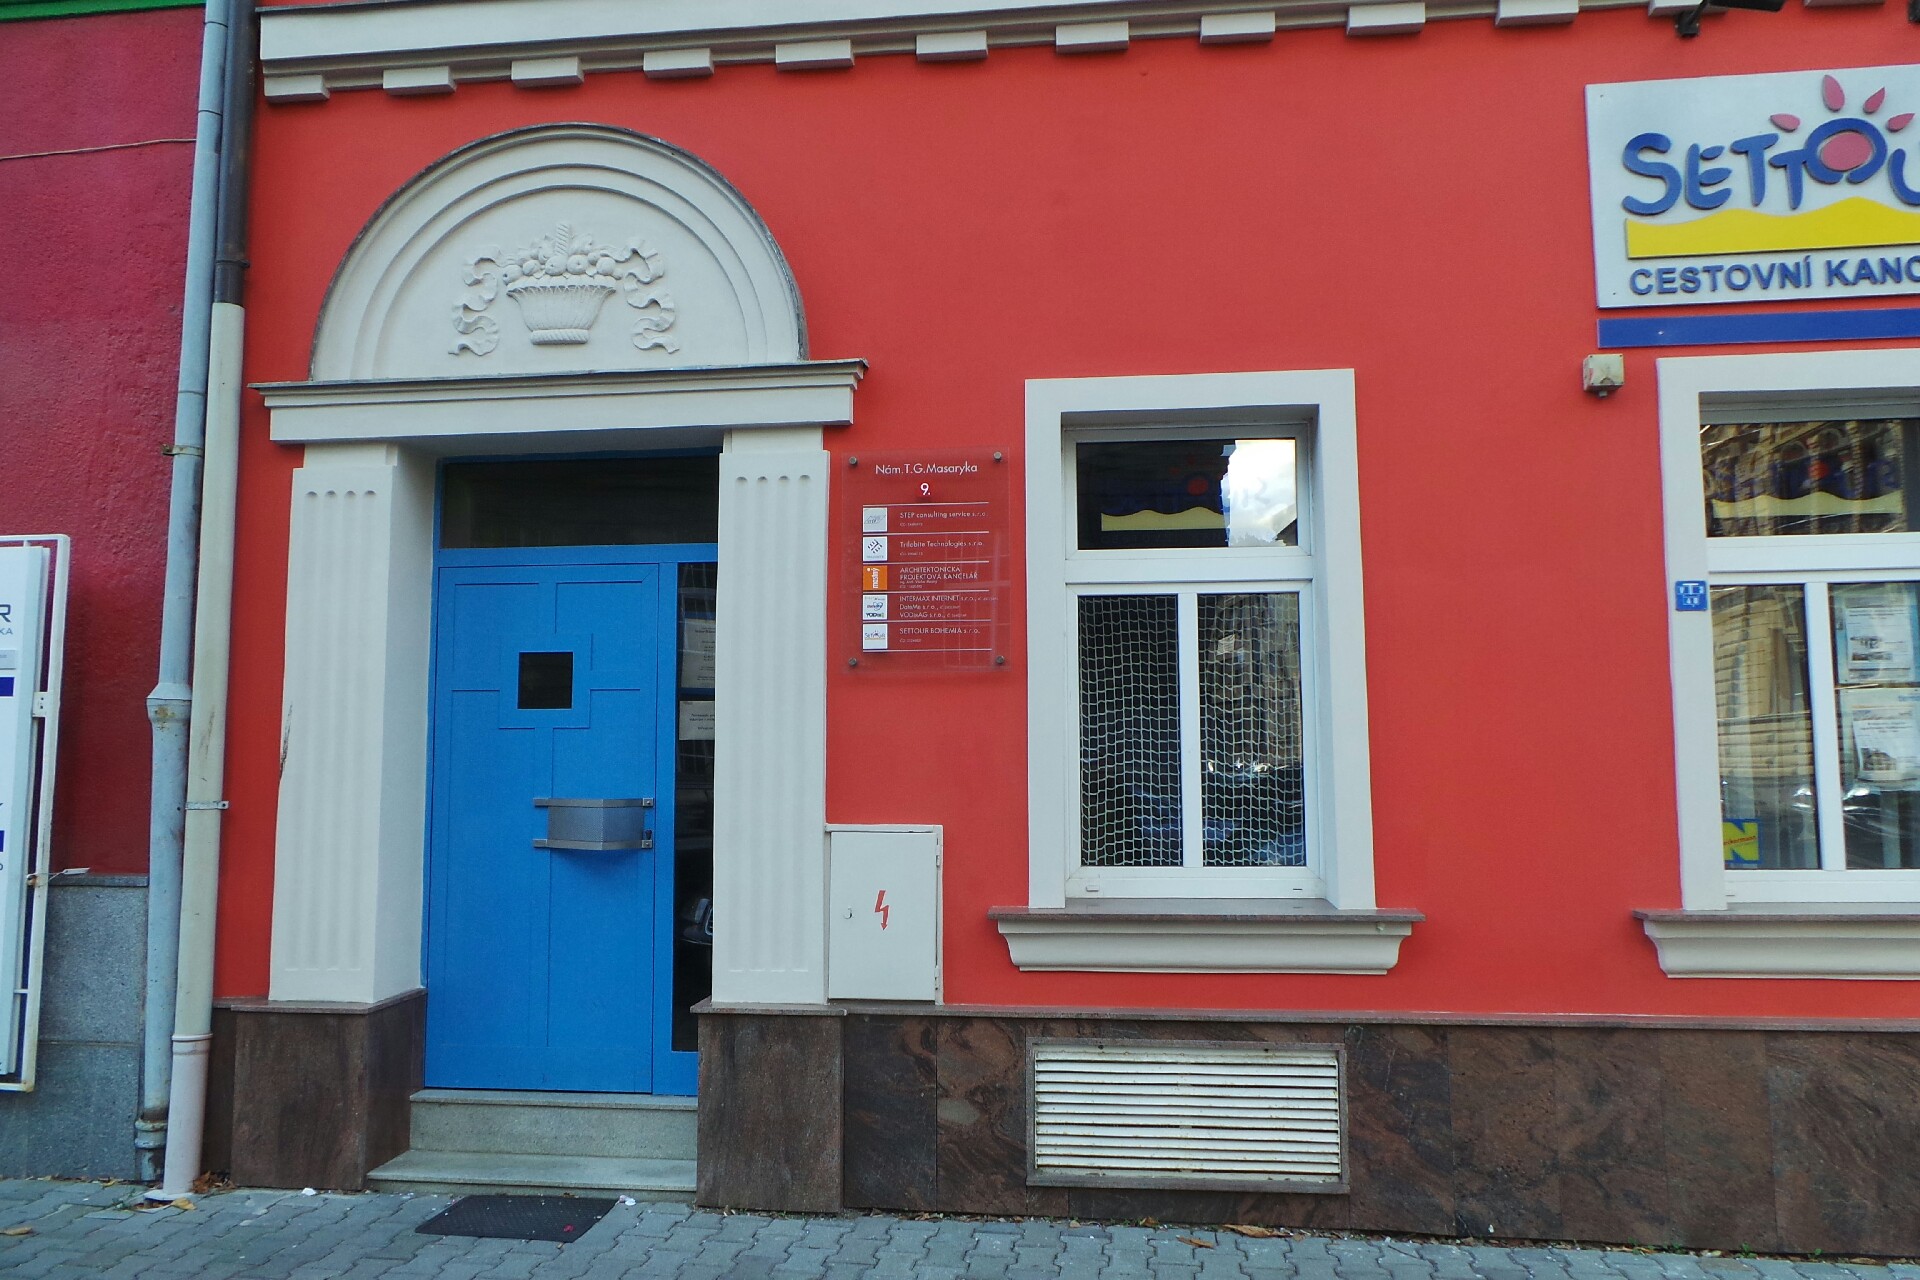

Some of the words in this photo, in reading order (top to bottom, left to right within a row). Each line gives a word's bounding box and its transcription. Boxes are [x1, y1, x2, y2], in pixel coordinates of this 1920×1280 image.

[1629, 255, 1812, 296] CESTOVNÍ
[920, 482, 931, 496] 9.
[899, 511, 916, 519] STEP
[916, 510, 948, 519] consulting
[949, 510, 971, 518] service
[926, 539, 967, 549] Technologies
[931, 594, 960, 602] INTERNET
[899, 627, 930, 635] SETTOUR
[930, 626, 963, 634] BOHEMIA
